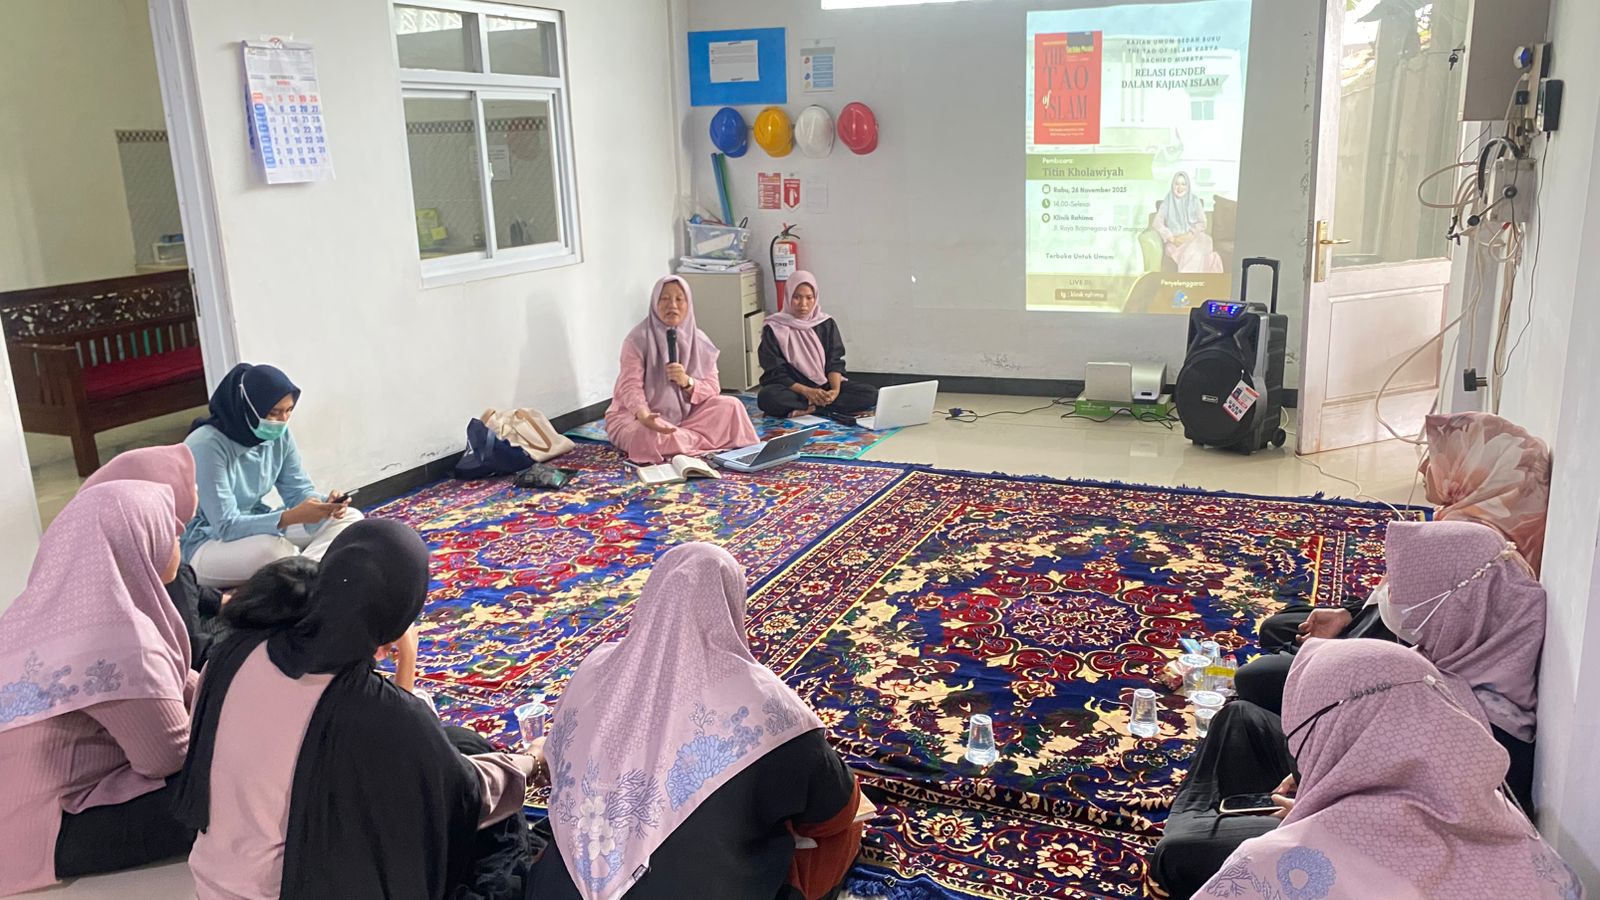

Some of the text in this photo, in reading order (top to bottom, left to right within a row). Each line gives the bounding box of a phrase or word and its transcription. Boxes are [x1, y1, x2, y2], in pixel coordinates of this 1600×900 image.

[1042, 65, 1089, 90] TAO
[1135, 67, 1206, 77] RELASI GENDER
[1121, 78, 1219, 91] DALAM KAJIAN ISLAM
[1042, 90, 1052, 109] of
[290, 105, 296, 113] 13
[288, 157, 295, 165] 11
[1042, 167, 1124, 179] Titin Kholawiyah
